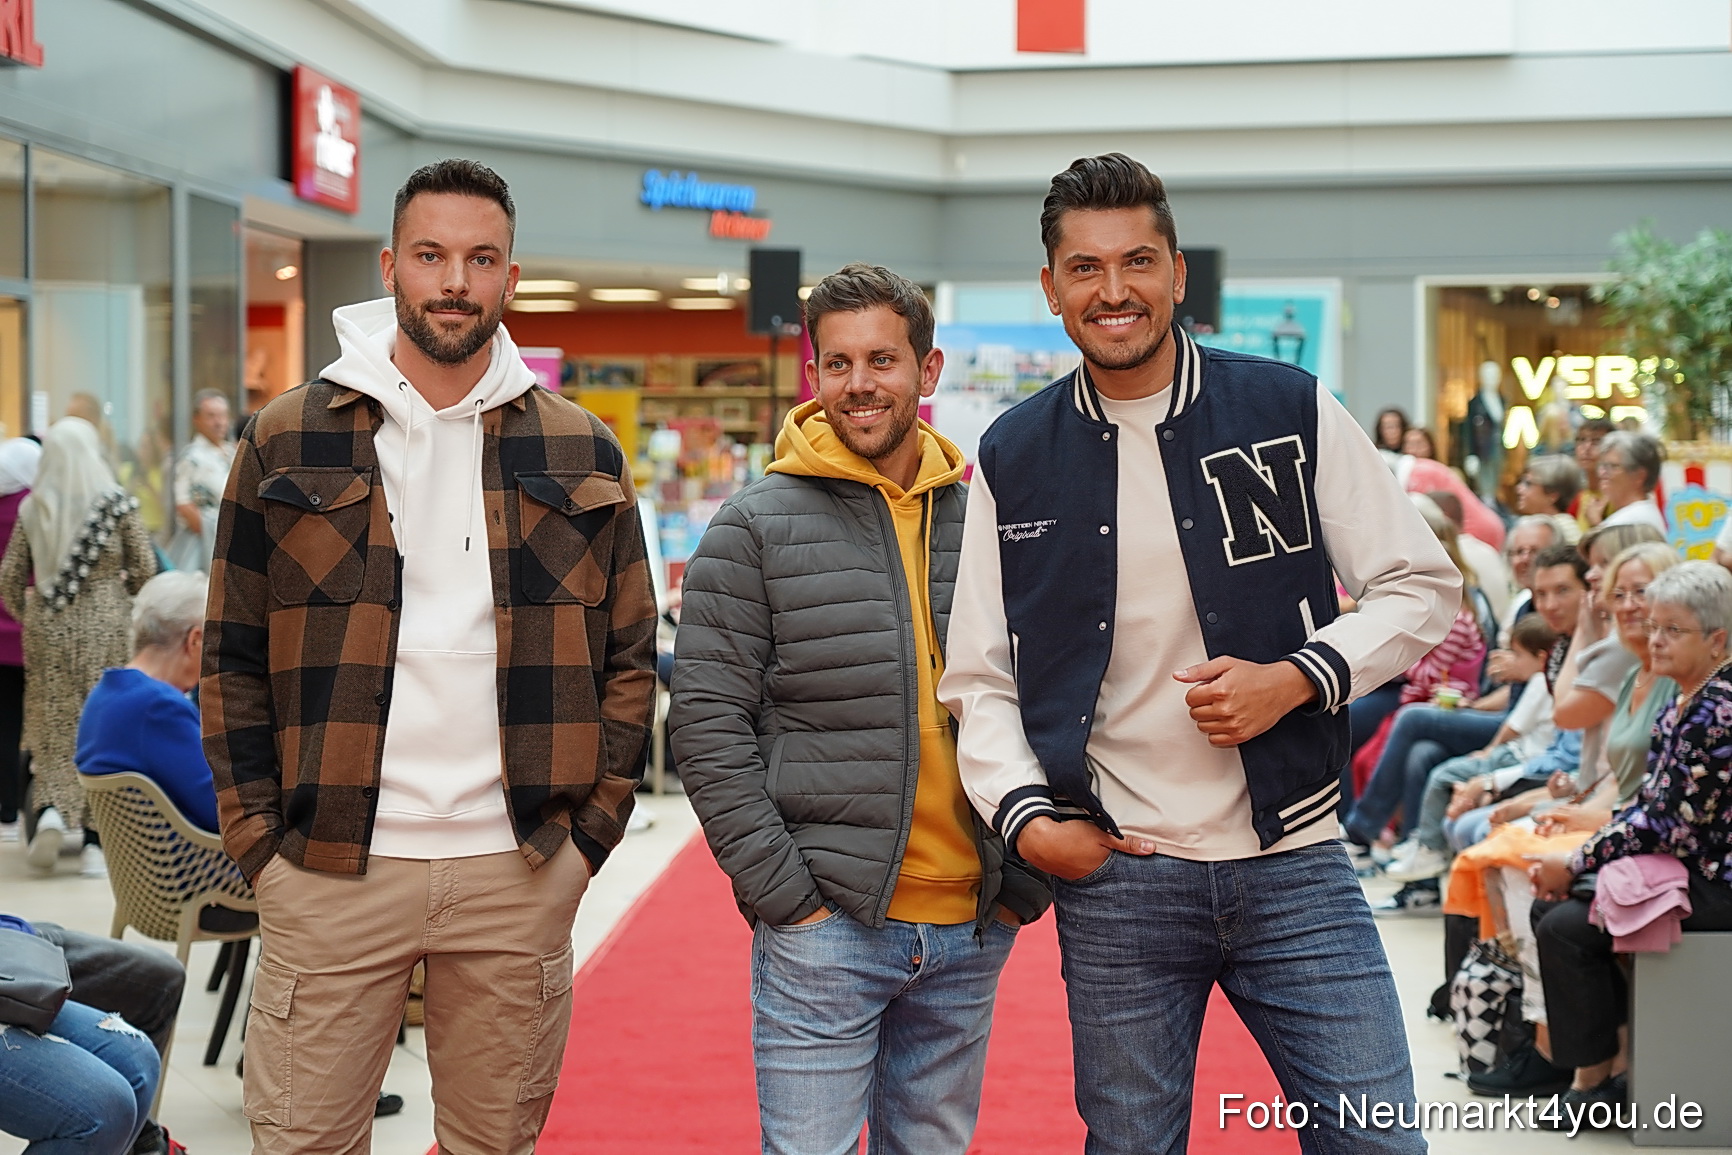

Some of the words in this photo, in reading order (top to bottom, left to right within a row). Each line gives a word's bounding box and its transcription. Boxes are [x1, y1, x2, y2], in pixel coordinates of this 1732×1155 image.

[1002, 522, 1033, 531] NINETEEN
[1033, 519, 1058, 528] NINETY
[1199, 434, 1313, 567] N
